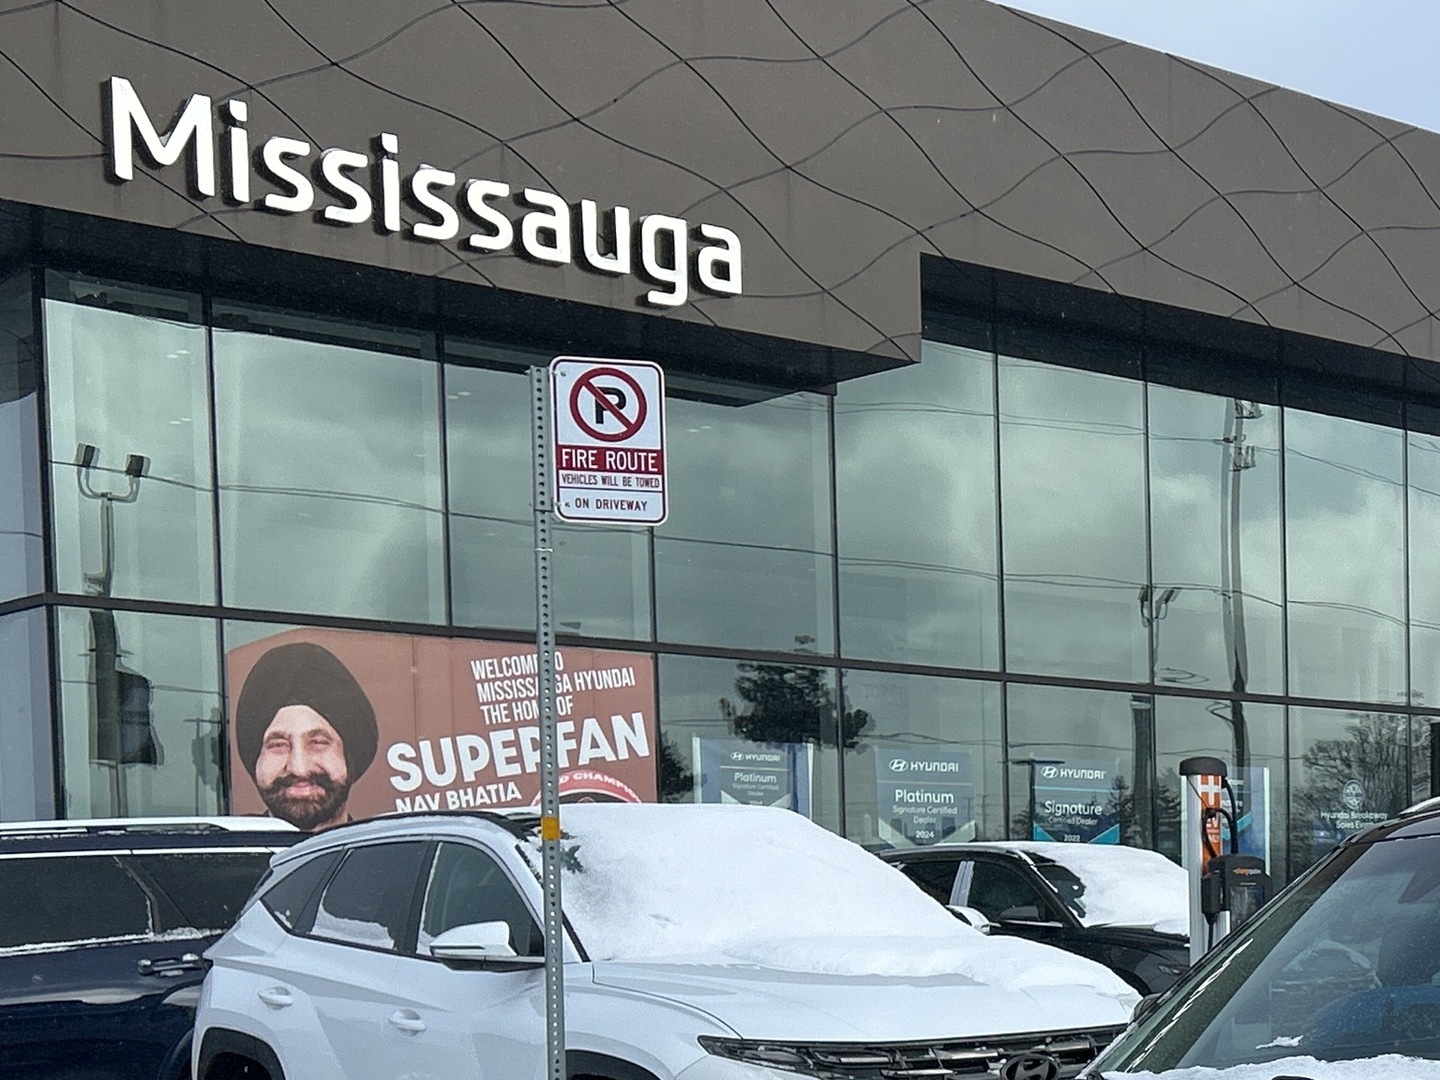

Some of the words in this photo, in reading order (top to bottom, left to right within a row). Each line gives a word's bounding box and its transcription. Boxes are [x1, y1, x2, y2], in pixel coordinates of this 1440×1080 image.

[109, 75, 743, 307] Mississauga
[561, 448, 598, 469] FIRE
[605, 450, 659, 472] ROUTE
[561, 473, 598, 486] VEHICLES
[601, 475, 619, 487] WILL
[622, 476, 633, 487] BE
[636, 477, 660, 488] TOWED
[575, 497, 589, 509] ON
[595, 498, 648, 511] DRIVEWAY
[573, 666, 636, 692] HYUNDAI
[480, 702, 512, 725] THE
[512, 699, 540, 721] HOM
[555, 695, 574, 716] OF
[910, 761, 960, 773] HYUNDAI
[1060, 768, 1104, 780] HYUNDAI
[734, 771, 777, 783] Platinum
[395, 792, 441, 813] NAV
[445, 781, 522, 810] BHATIA
[894, 789, 954, 804] Platinum
[892, 805, 926, 815] Signature
[1044, 800, 1103, 817] Signature
[915, 830, 935, 838] 2024
